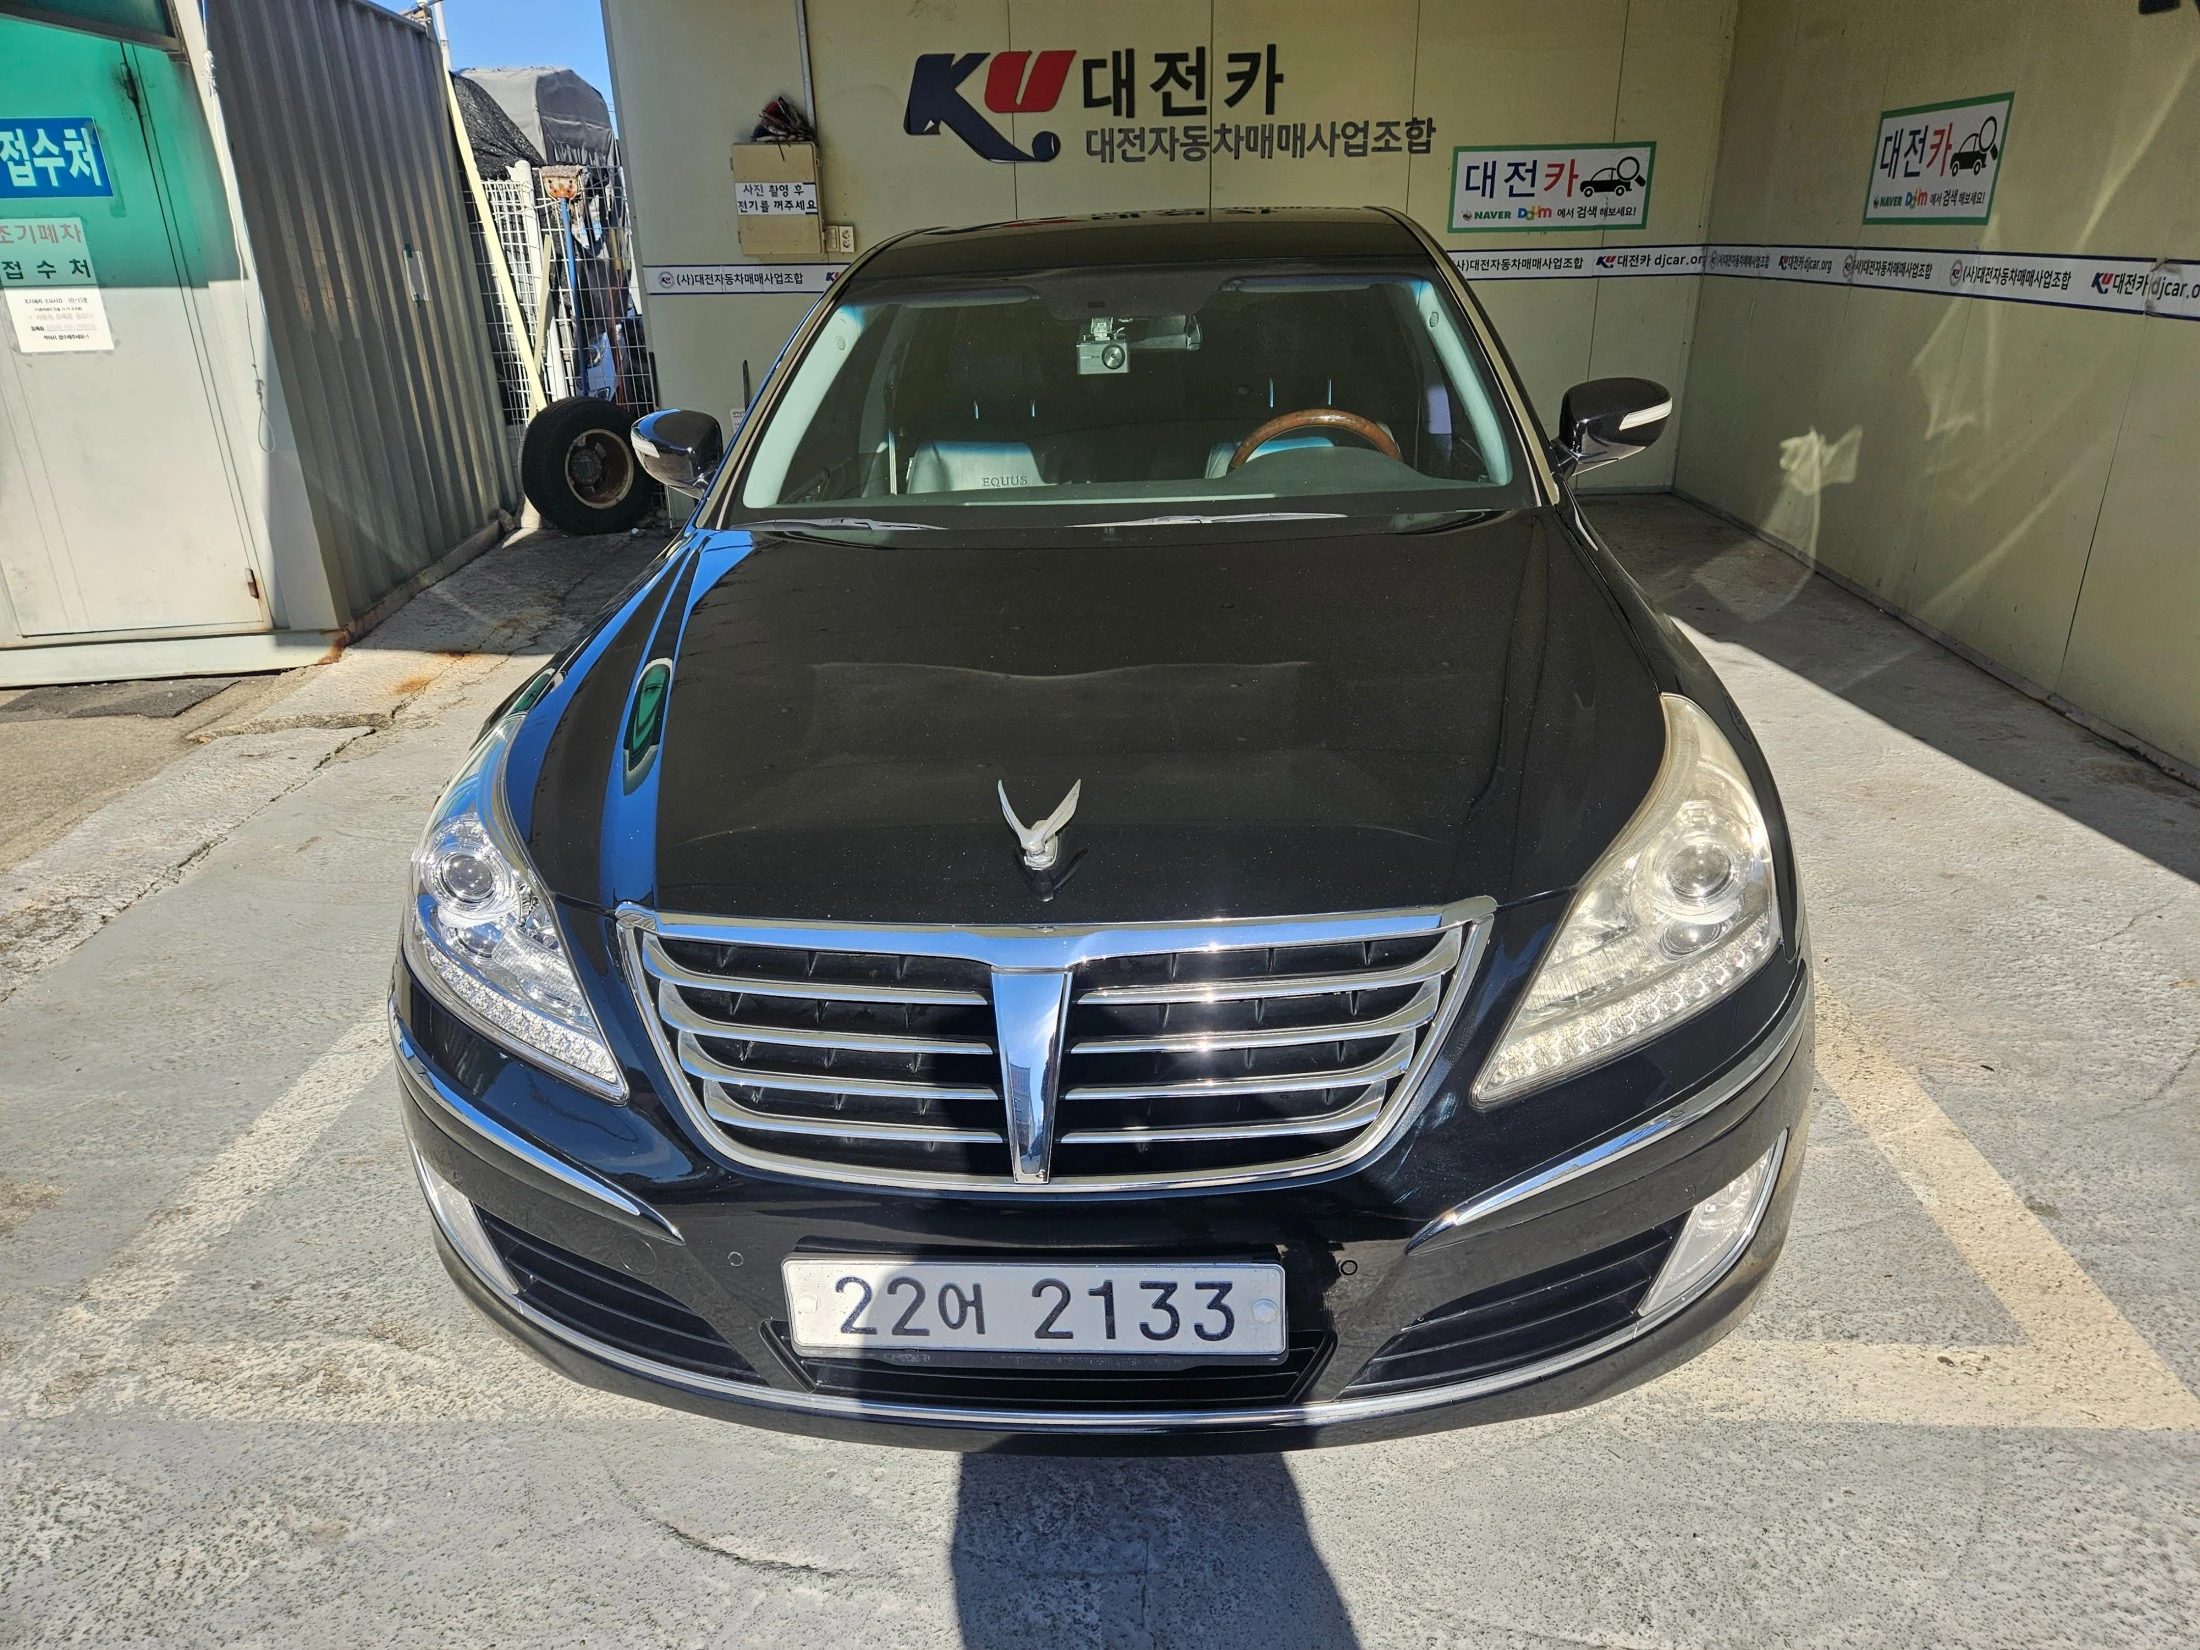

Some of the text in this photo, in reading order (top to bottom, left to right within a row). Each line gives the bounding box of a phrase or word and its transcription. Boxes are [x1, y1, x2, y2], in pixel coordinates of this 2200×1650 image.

[1082, 44, 1284, 118] 대전카
[1086, 117, 1437, 163] 대전자동차매매사업조합
[0, 127, 102, 187] 접수처
[1880, 122, 1952, 180] 대전카
[1464, 158, 1579, 199] 대전카
[743, 184, 804, 197] 사진 촬영 후
[1880, 196, 1902, 208] NAVER
[1942, 189, 1959, 207] 검색
[737, 200, 817, 213] 전기를 꺼주세요
[1474, 210, 1512, 220] NAVER
[1557, 208, 1574, 219] 에서
[1577, 206, 1598, 219] 검색
[1599, 206, 1637, 218] 해보세요!
[0, 223, 81, 245] 조기폐차
[1453, 258, 1584, 272] 사)대전자동차매매사업조합
[1617, 254, 1651, 268] 대전카
[1804, 256, 1833, 273] djcar.org
[676, 272, 803, 286] (사)대전자동차매매사업조합
[2112, 273, 2149, 296] 대전카
[981, 475, 1028, 487] EQUUS
[835, 1275, 1236, 1342] 22어 2133
